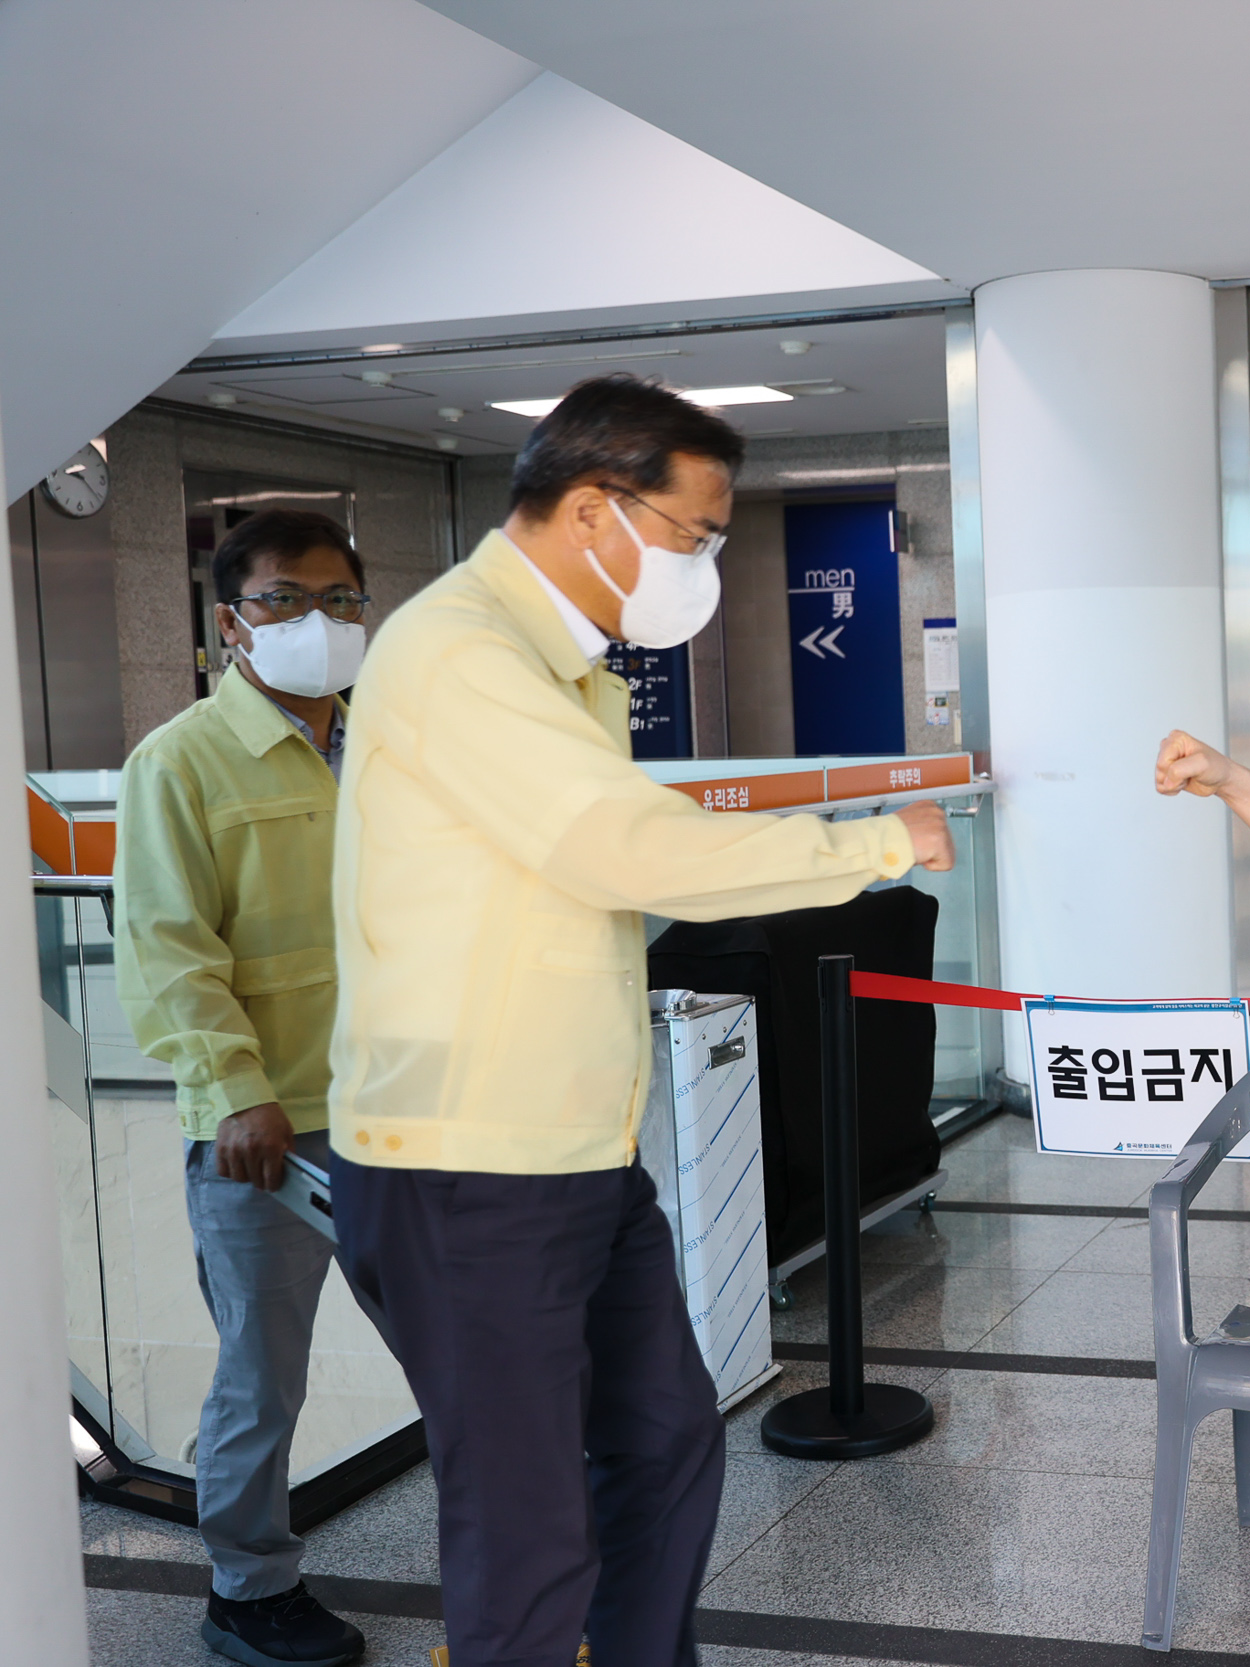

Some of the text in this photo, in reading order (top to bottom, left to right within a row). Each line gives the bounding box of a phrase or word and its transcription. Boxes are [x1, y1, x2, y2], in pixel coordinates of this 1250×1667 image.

[804, 567, 855, 588] men
[832, 592, 854, 619] 男
[628, 677, 642, 691] 2F
[630, 697, 643, 711] 1F
[630, 717, 645, 730] B1
[889, 768, 921, 788] 추락주의
[703, 786, 749, 811] 유리조심
[676, 1067, 706, 1099] STAINLESS
[1047, 1045, 1234, 1102] 출입금지
[678, 1143, 711, 1175] STAINLESS
[683, 1221, 715, 1254] STAINLESS
